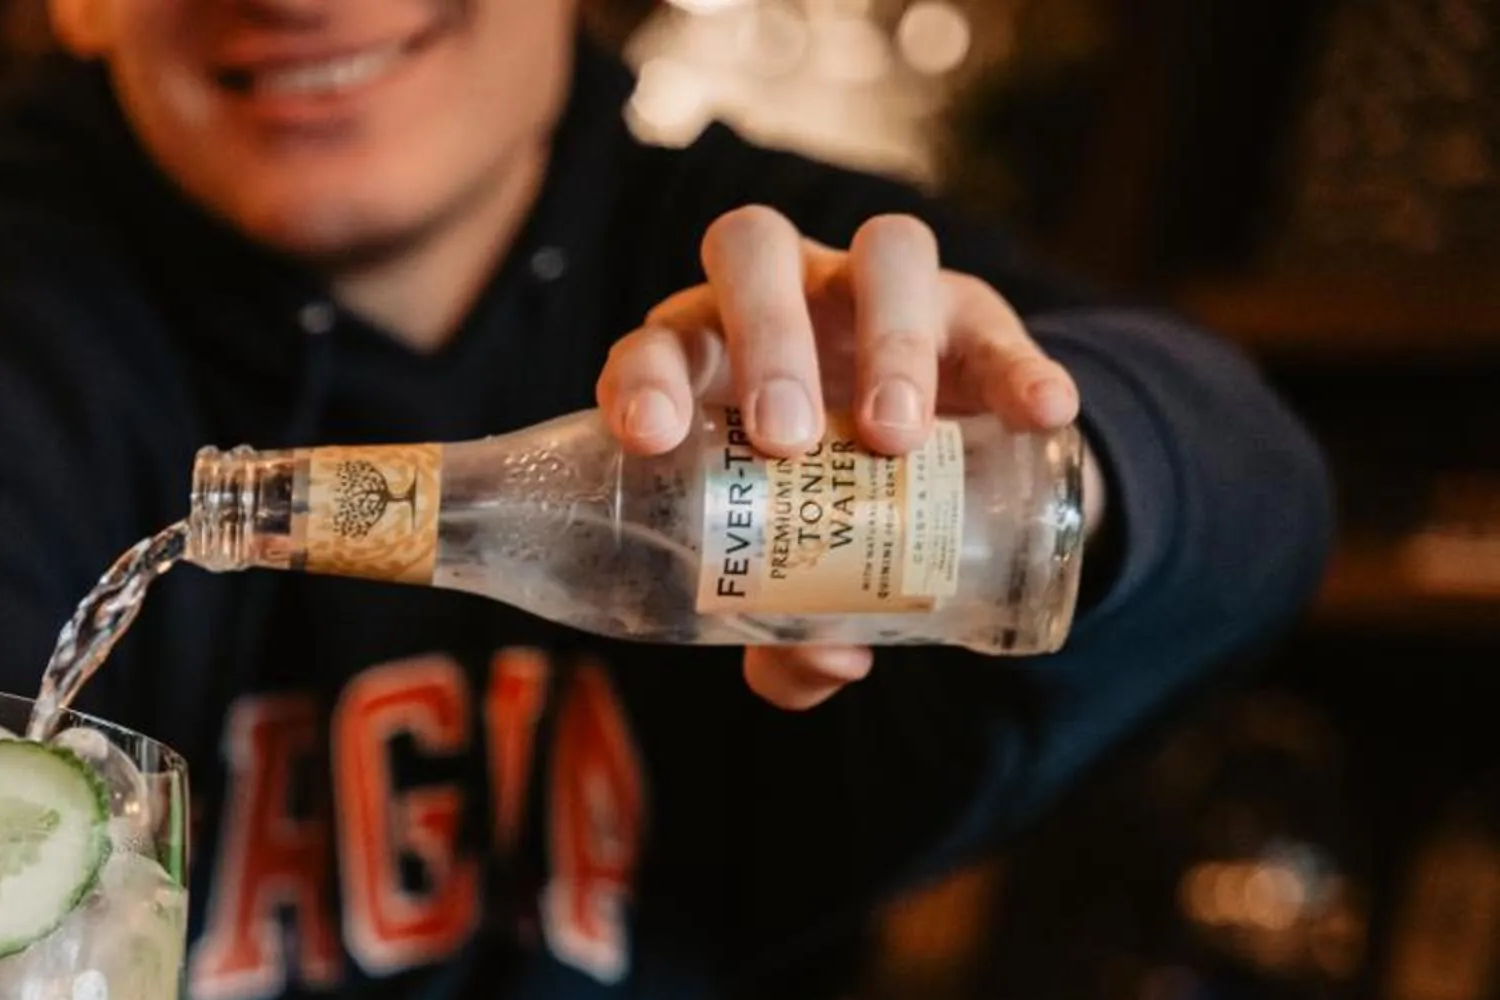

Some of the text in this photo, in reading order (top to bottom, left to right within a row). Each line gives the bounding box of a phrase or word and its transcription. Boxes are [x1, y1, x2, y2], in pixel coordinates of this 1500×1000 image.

[770, 481, 793, 579] PREMIUM
[829, 440, 856, 550] WATER
[877, 541, 893, 599] QUININE
